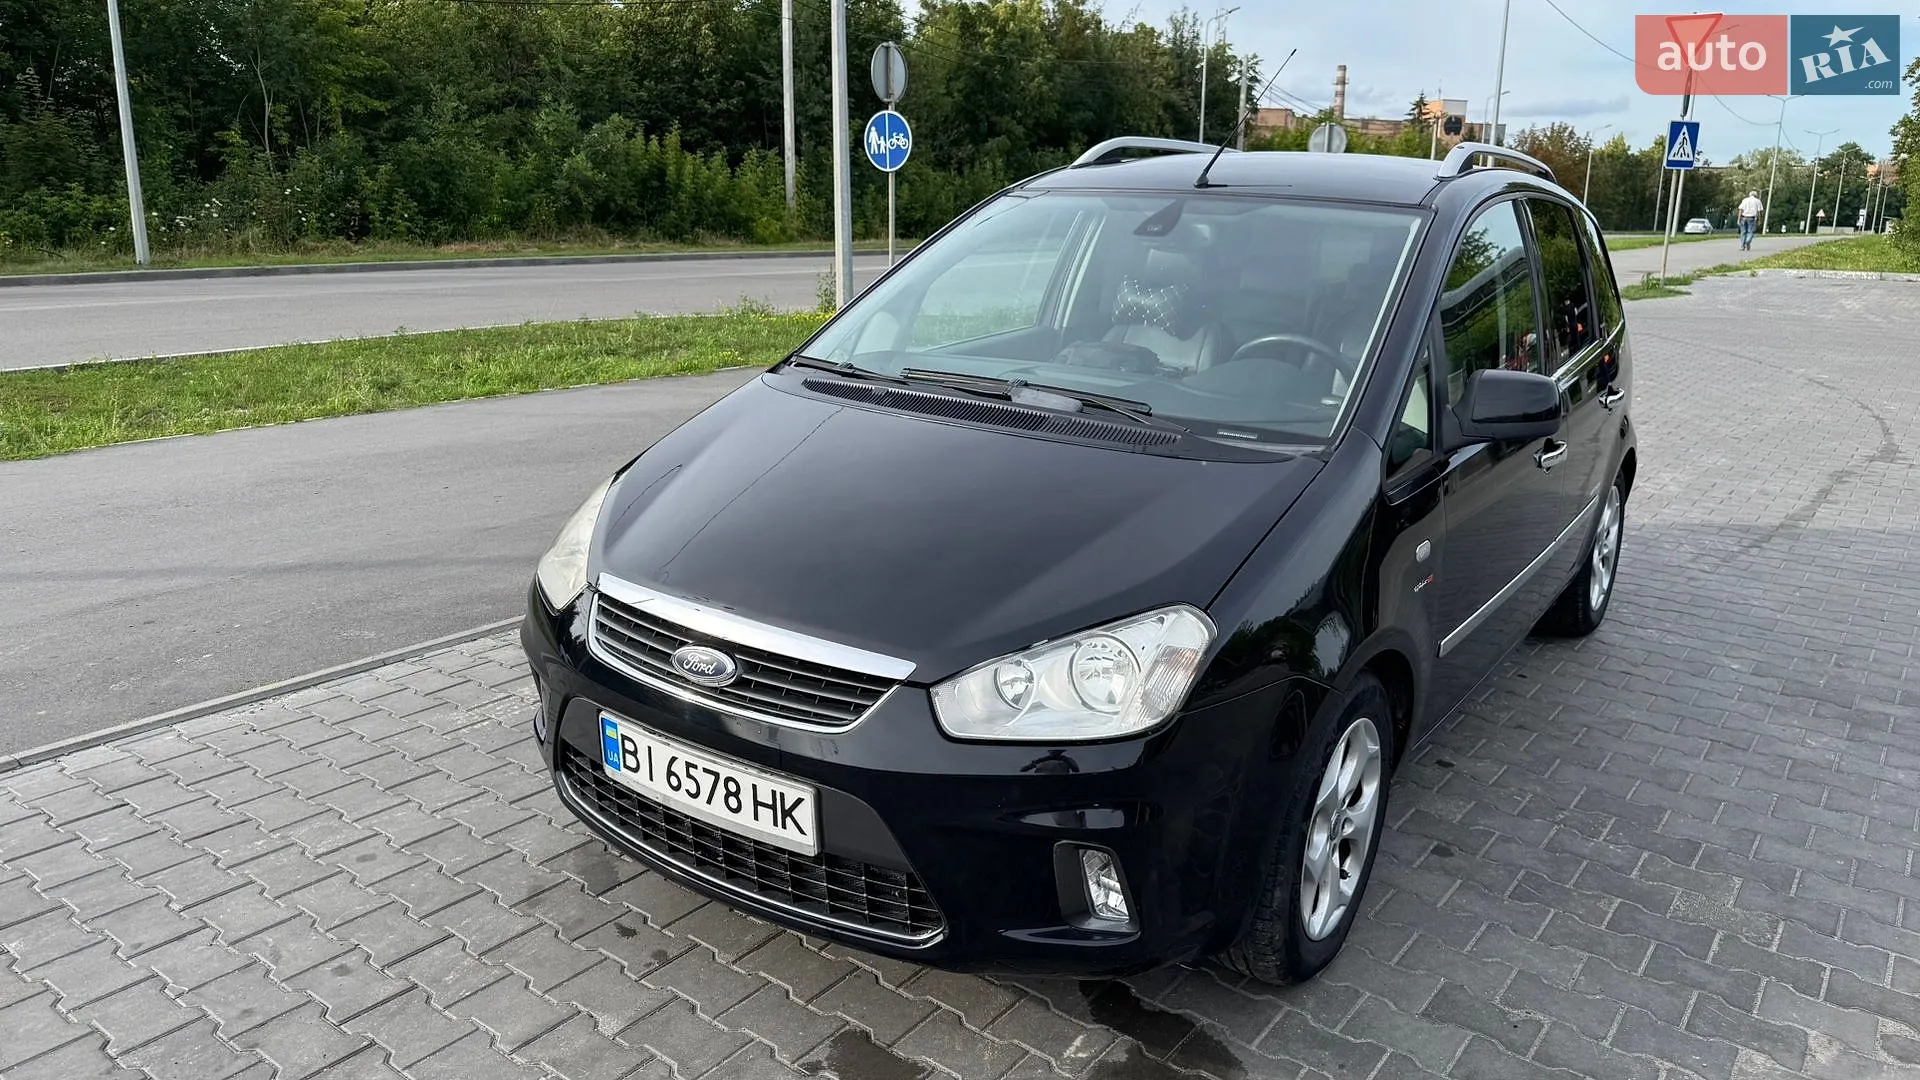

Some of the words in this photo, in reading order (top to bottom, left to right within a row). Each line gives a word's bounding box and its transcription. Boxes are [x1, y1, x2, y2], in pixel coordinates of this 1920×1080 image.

[683, 652, 717, 675] Ford
[607, 749, 620, 764] UA
[620, 732, 654, 782] BI
[666, 755, 742, 814] 6578
[751, 783, 808, 836] HK
